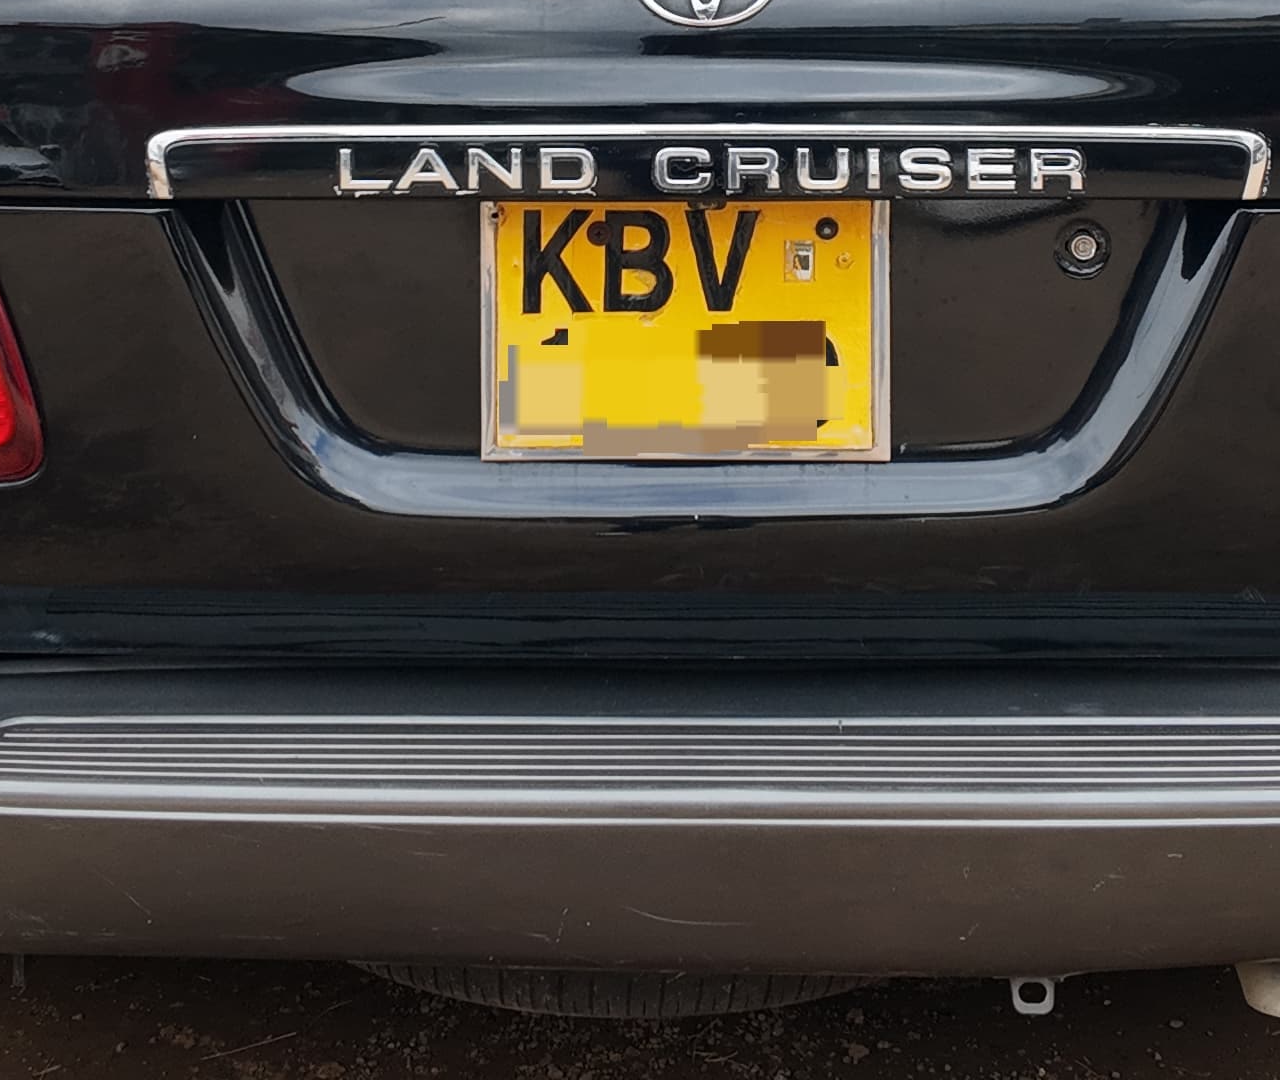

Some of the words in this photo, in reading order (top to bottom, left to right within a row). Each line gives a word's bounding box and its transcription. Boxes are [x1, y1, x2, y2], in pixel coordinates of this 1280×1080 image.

[338, 147, 597, 192] LAND
[653, 146, 1085, 193] CRUISER
[522, 209, 761, 315] KBV
